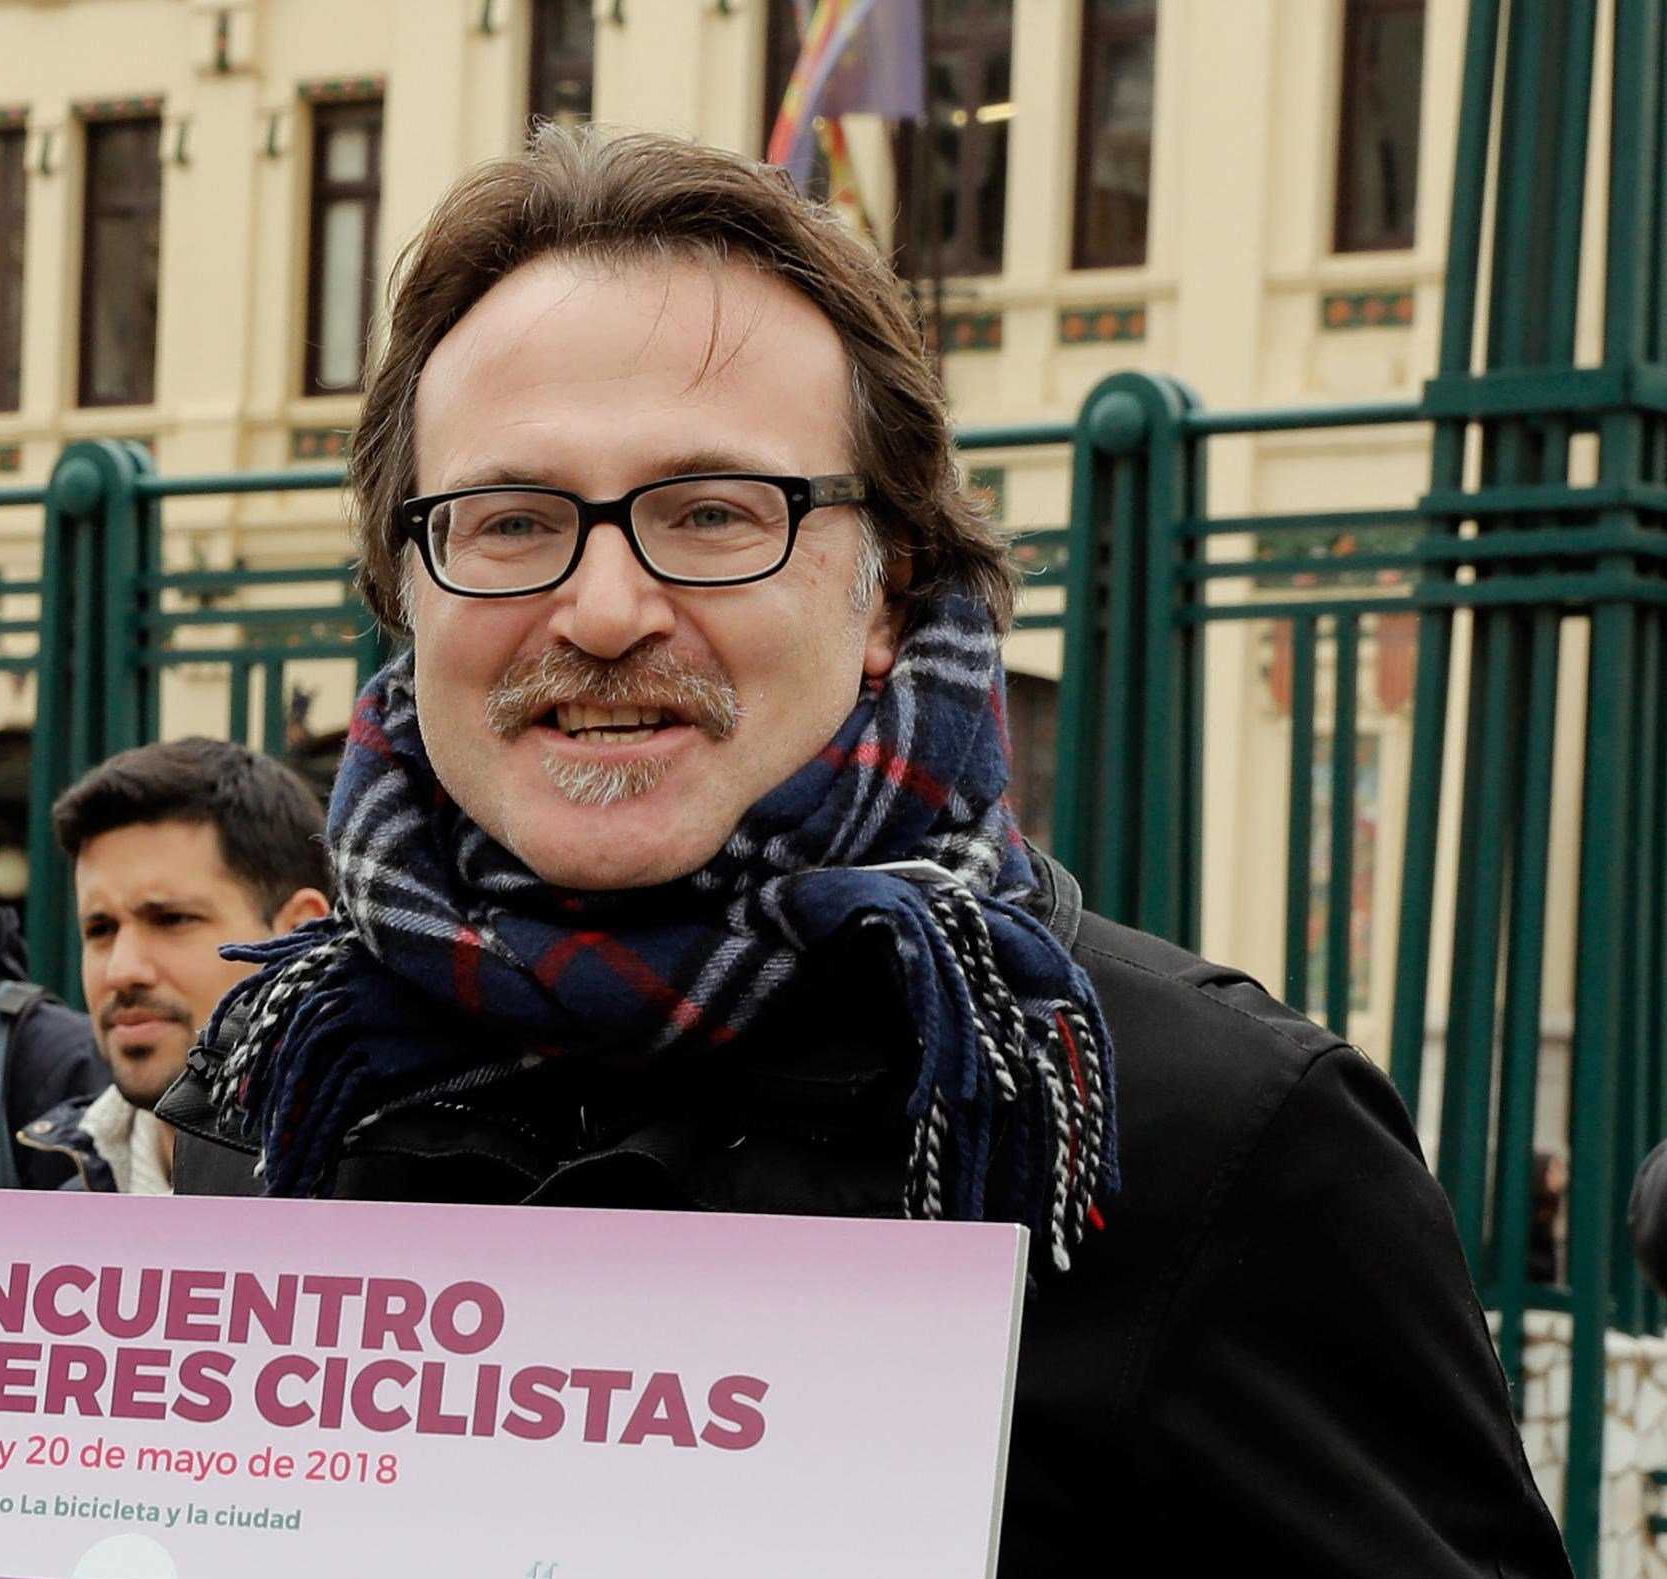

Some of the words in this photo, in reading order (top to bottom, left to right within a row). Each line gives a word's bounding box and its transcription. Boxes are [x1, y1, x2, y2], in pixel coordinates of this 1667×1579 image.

[254, 1354, 770, 1451] CICLISTAS
[25, 1435, 70, 1466] 20
[79, 1437, 126, 1469] de
[136, 1447, 238, 1482] mayo
[247, 1446, 295, 1479] de
[305, 1450, 397, 1485] 2018
[20, 1494, 47, 1516] La
[54, 1495, 160, 1522] bicicleta
[164, 1507, 181, 1529] y
[186, 1503, 208, 1525] la
[214, 1504, 302, 1530] ciudad
